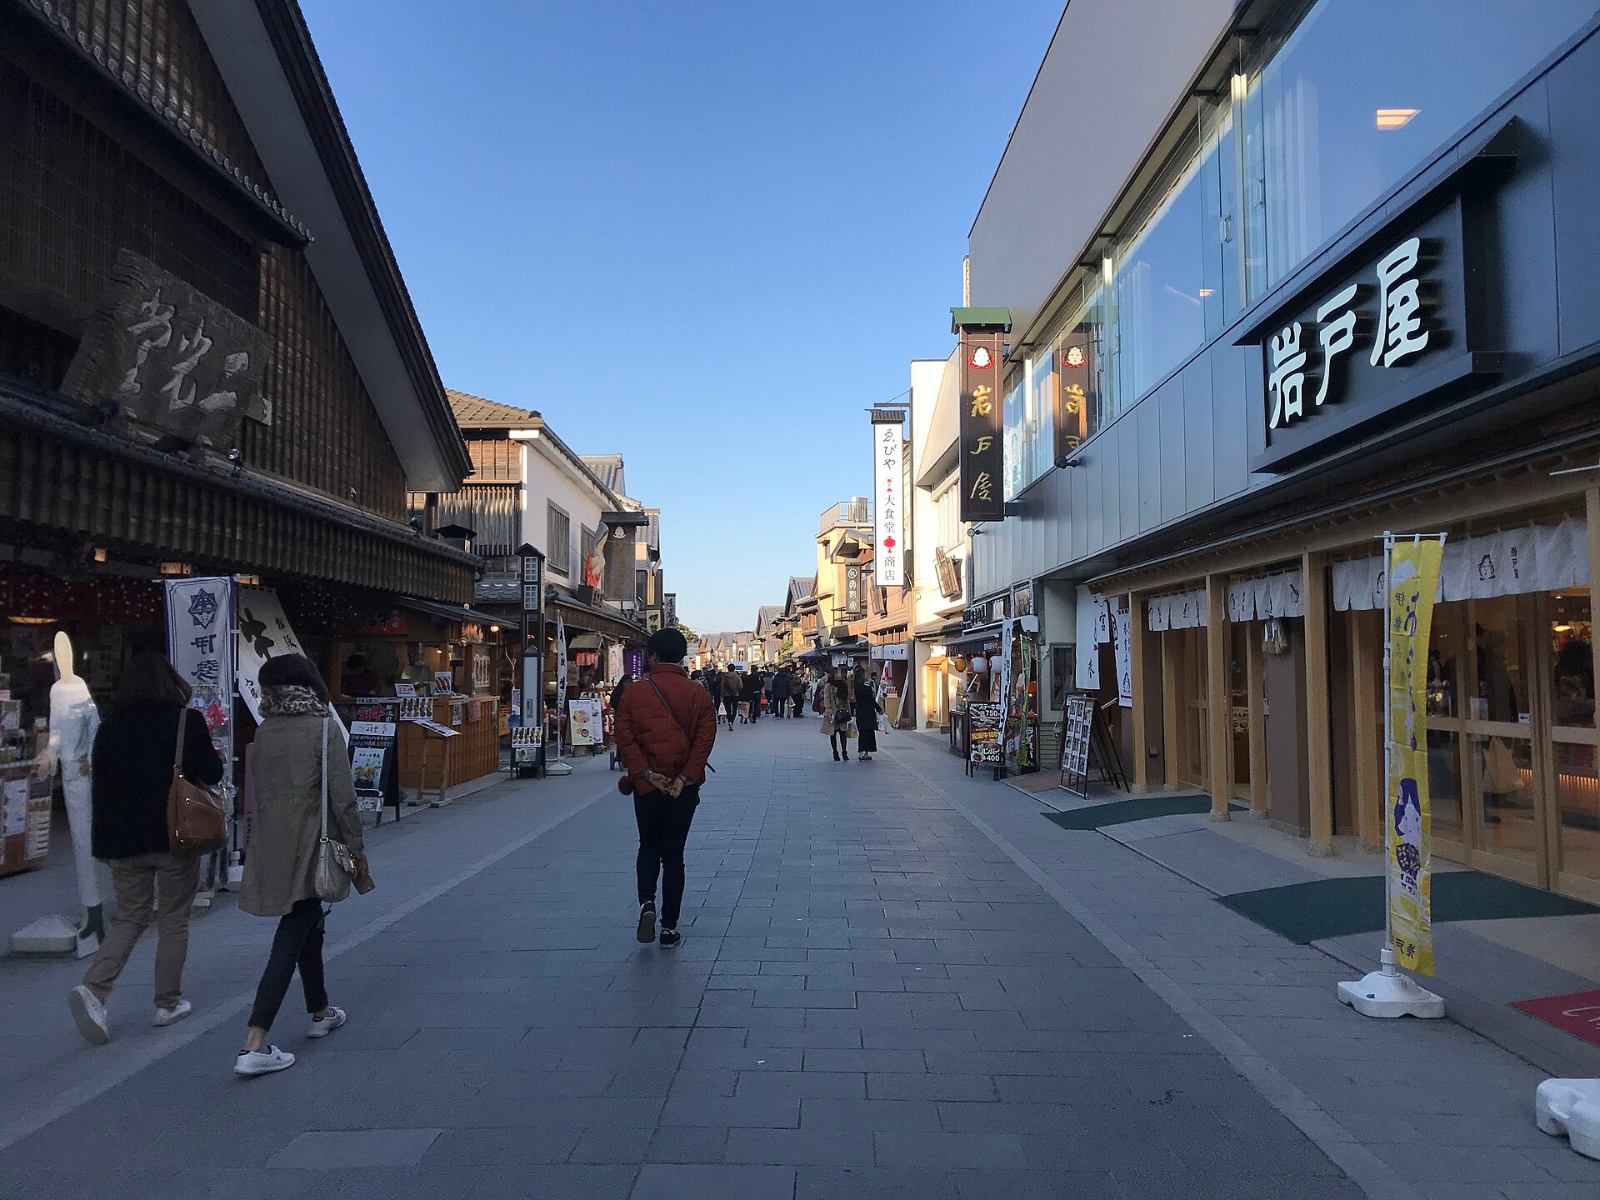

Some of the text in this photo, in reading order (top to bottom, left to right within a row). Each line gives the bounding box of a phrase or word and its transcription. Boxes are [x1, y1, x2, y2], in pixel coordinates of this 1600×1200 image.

[1269, 237, 1429, 429] 岩戸屋
[883, 428, 897, 581] ゑびや 大食堂 商店
[970, 384, 993, 502] 岩戸屋
